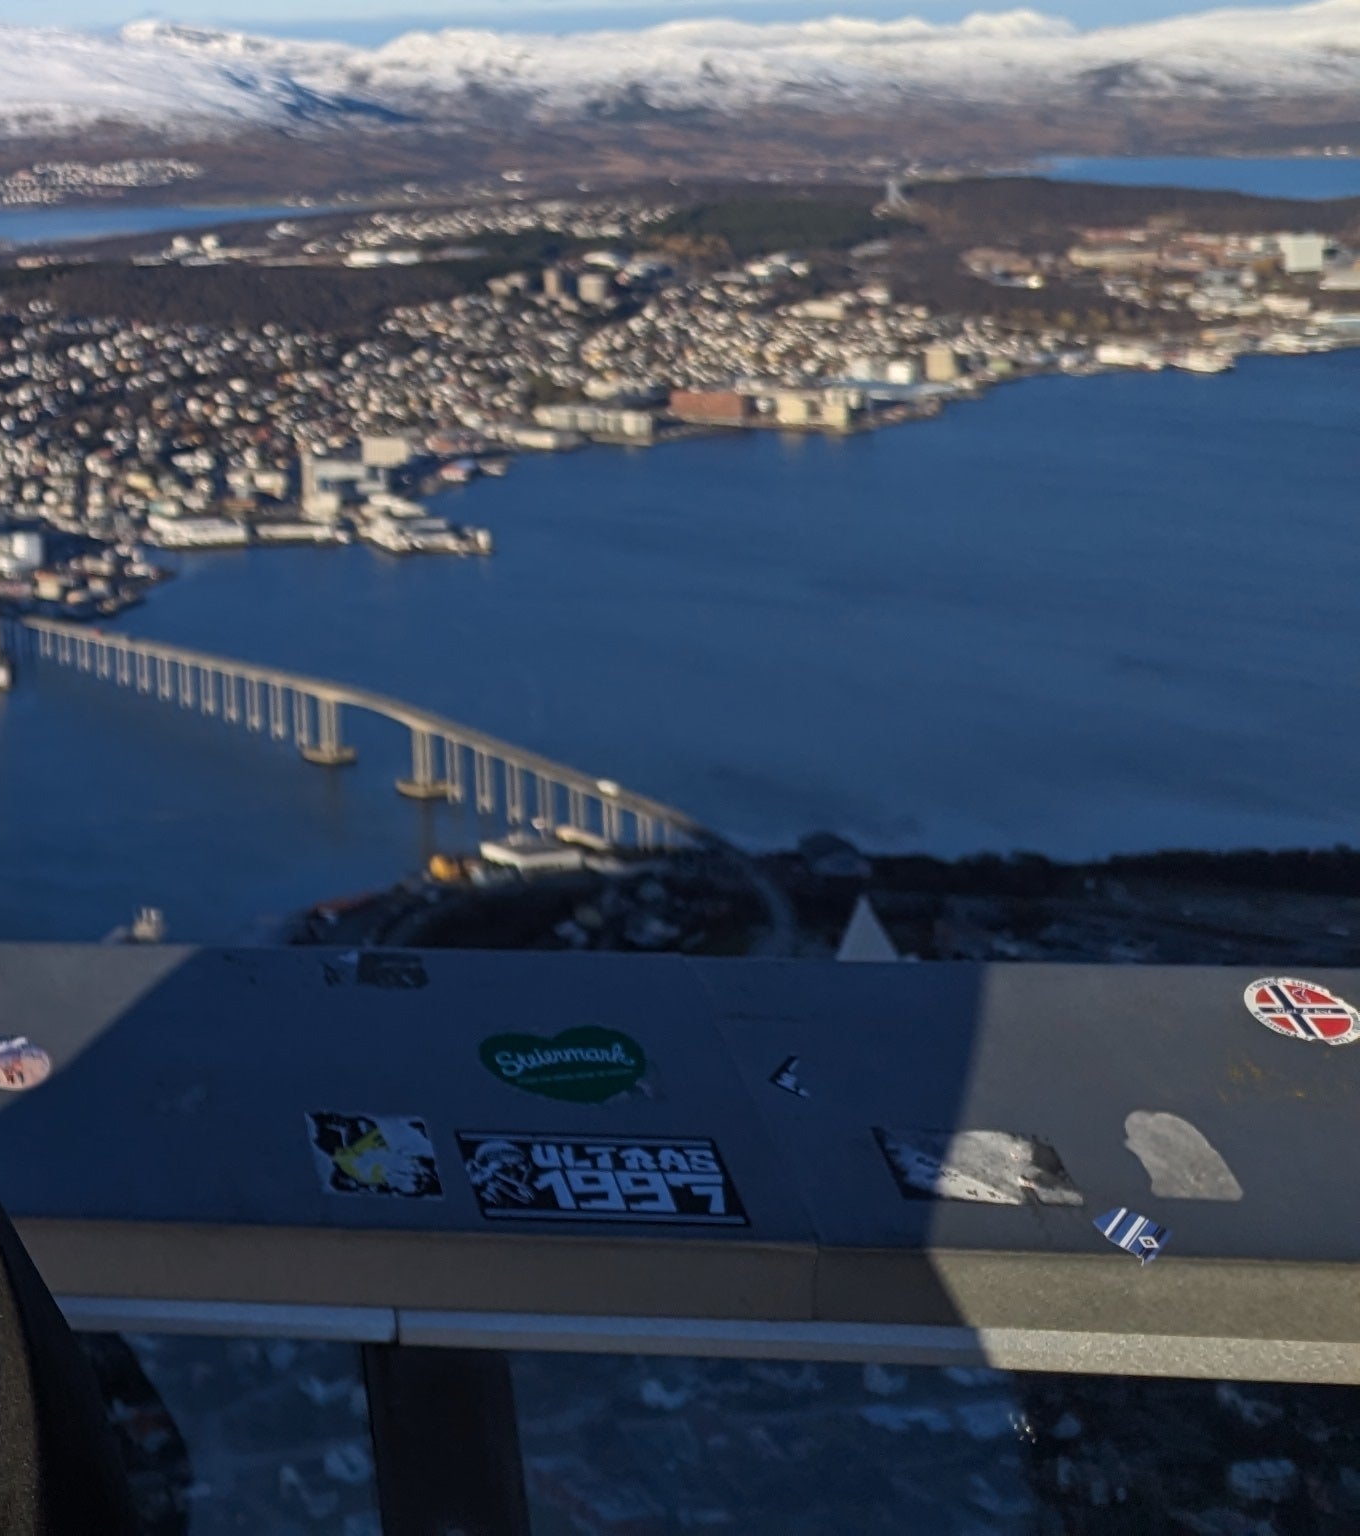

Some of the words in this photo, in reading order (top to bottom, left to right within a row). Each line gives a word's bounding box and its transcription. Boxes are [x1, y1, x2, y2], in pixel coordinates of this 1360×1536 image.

[495, 1042, 635, 1076] Steiermark
[531, 1144, 720, 1172] ULTRAS
[534, 1169, 726, 1214] 1997
